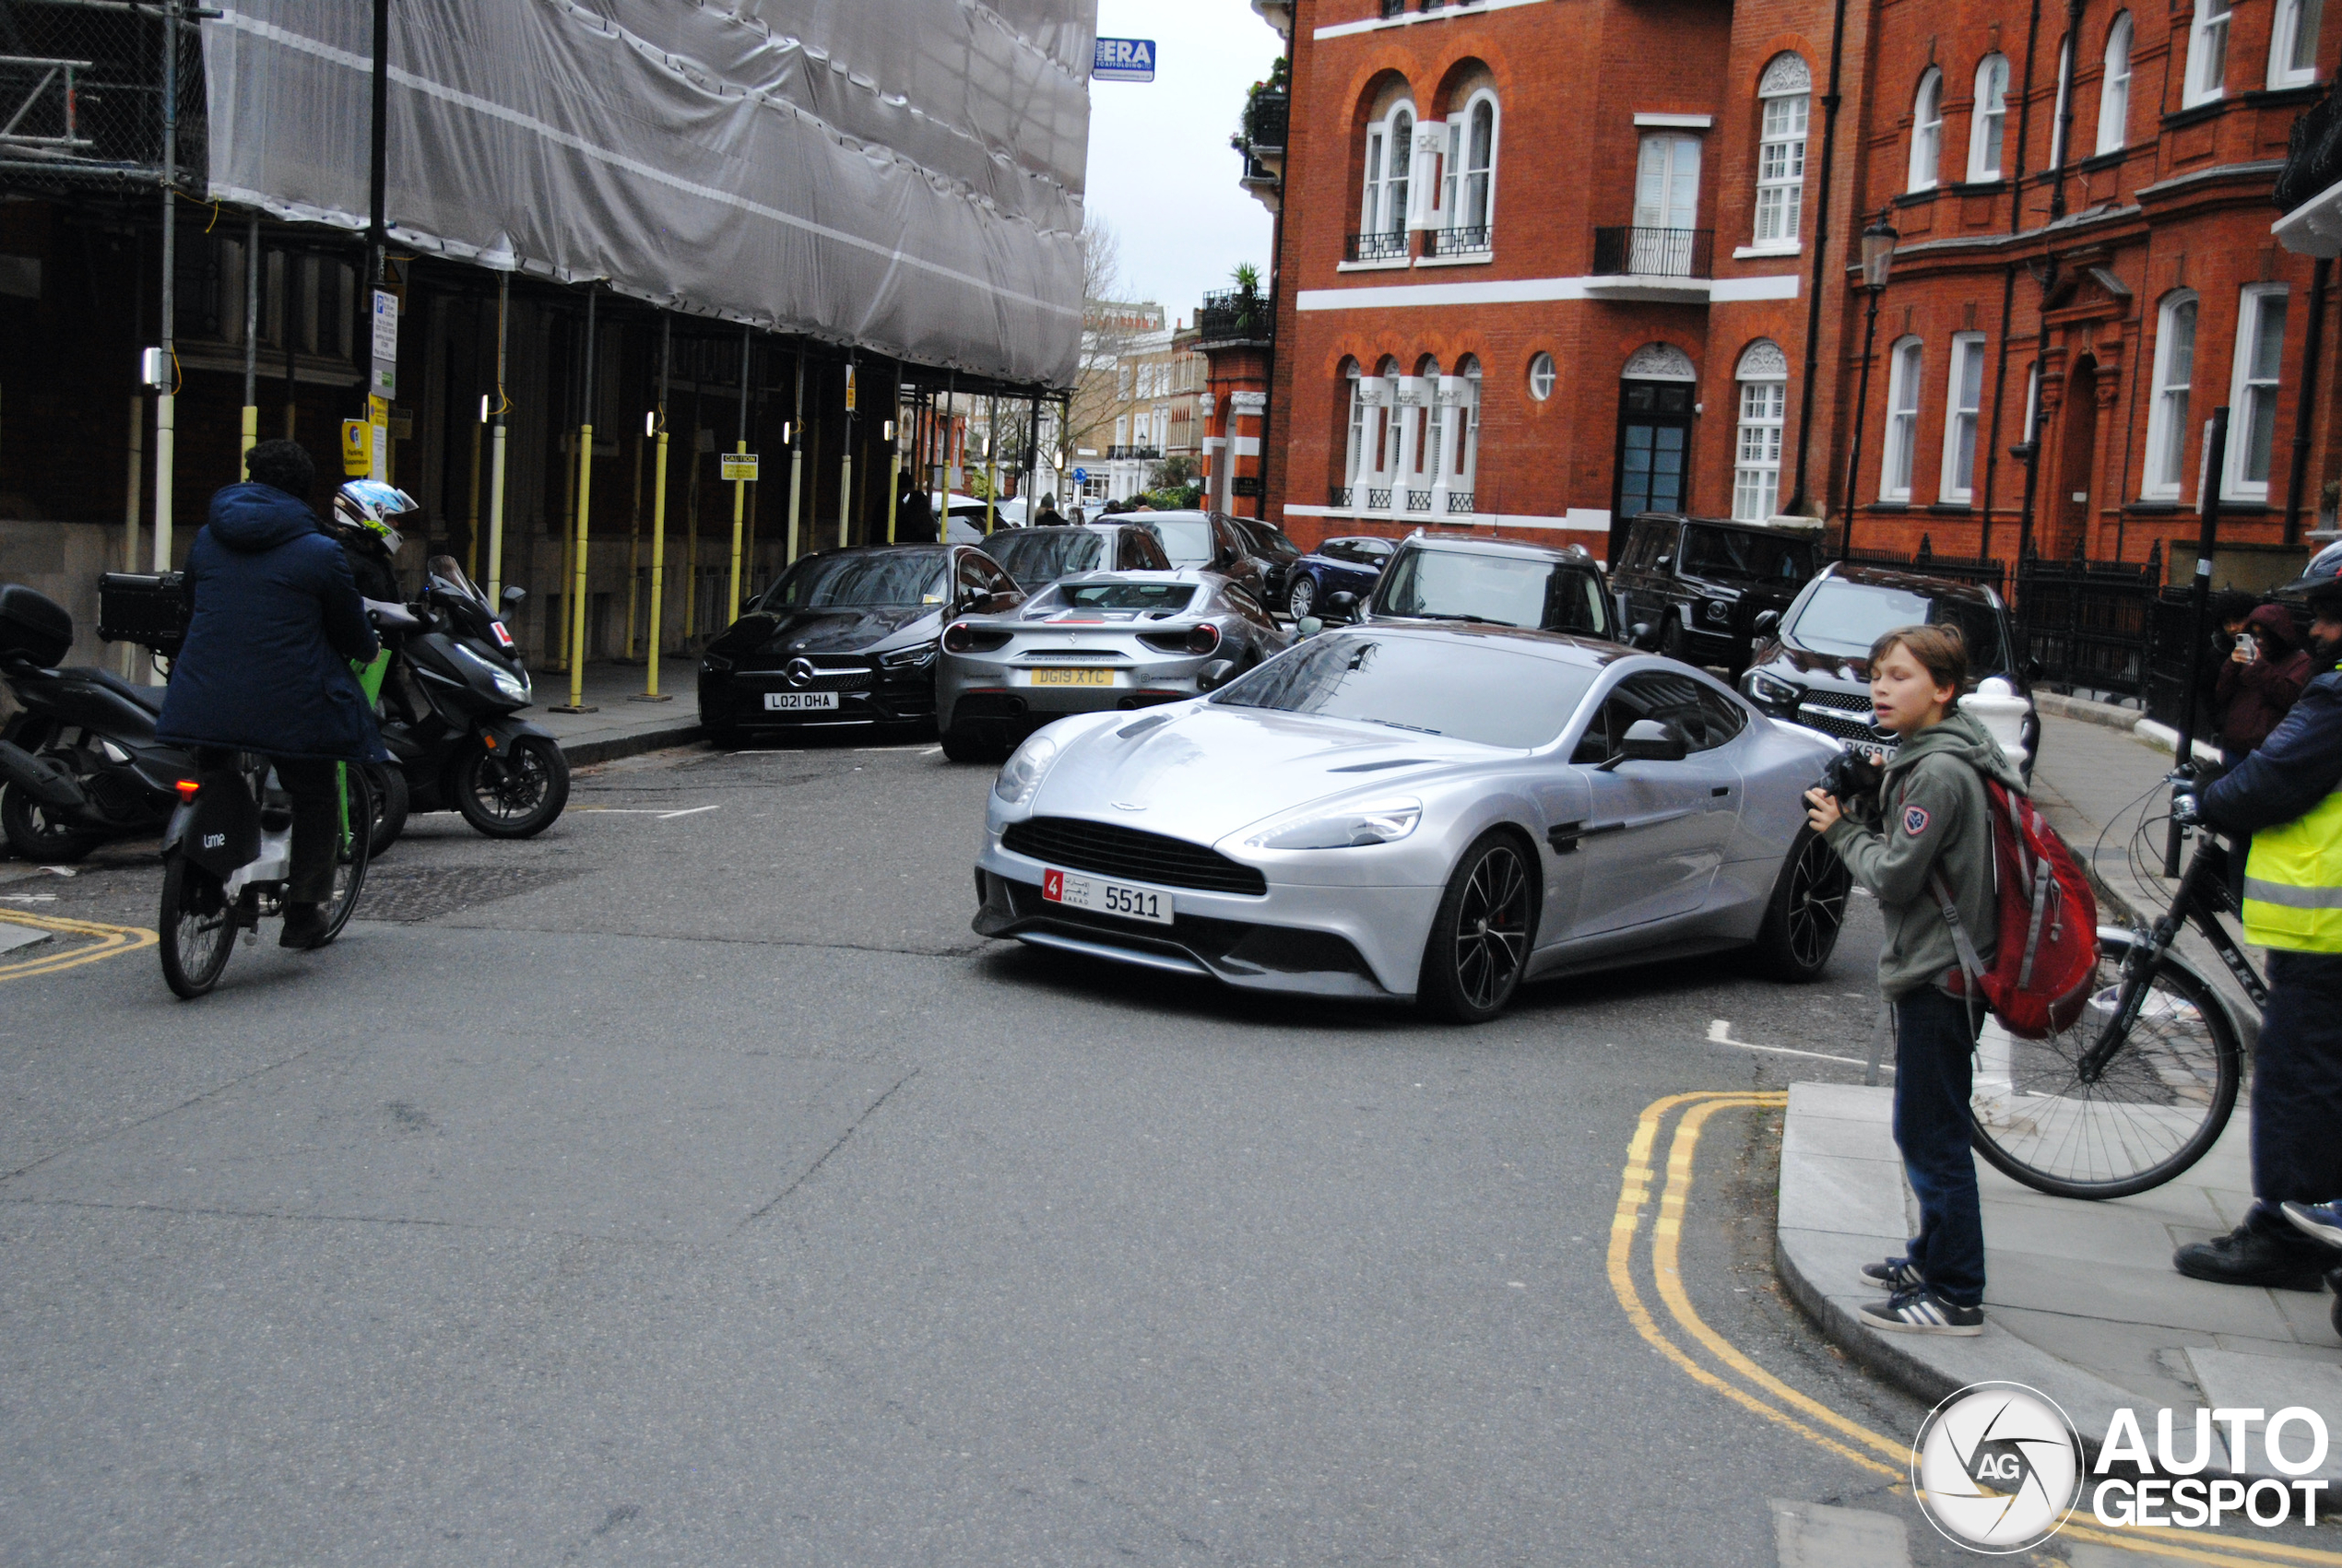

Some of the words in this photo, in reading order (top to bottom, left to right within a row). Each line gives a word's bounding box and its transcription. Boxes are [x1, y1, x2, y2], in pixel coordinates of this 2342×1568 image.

[1104, 41, 1151, 63] ERA
[495, 624, 513, 643] L
[1040, 669, 1071, 683] DG19
[1076, 669, 1105, 683] XTC
[772, 695, 801, 708] LO21
[804, 694, 831, 707] OHA
[1048, 876, 1059, 895] 4
[1106, 886, 1160, 918] 5511
